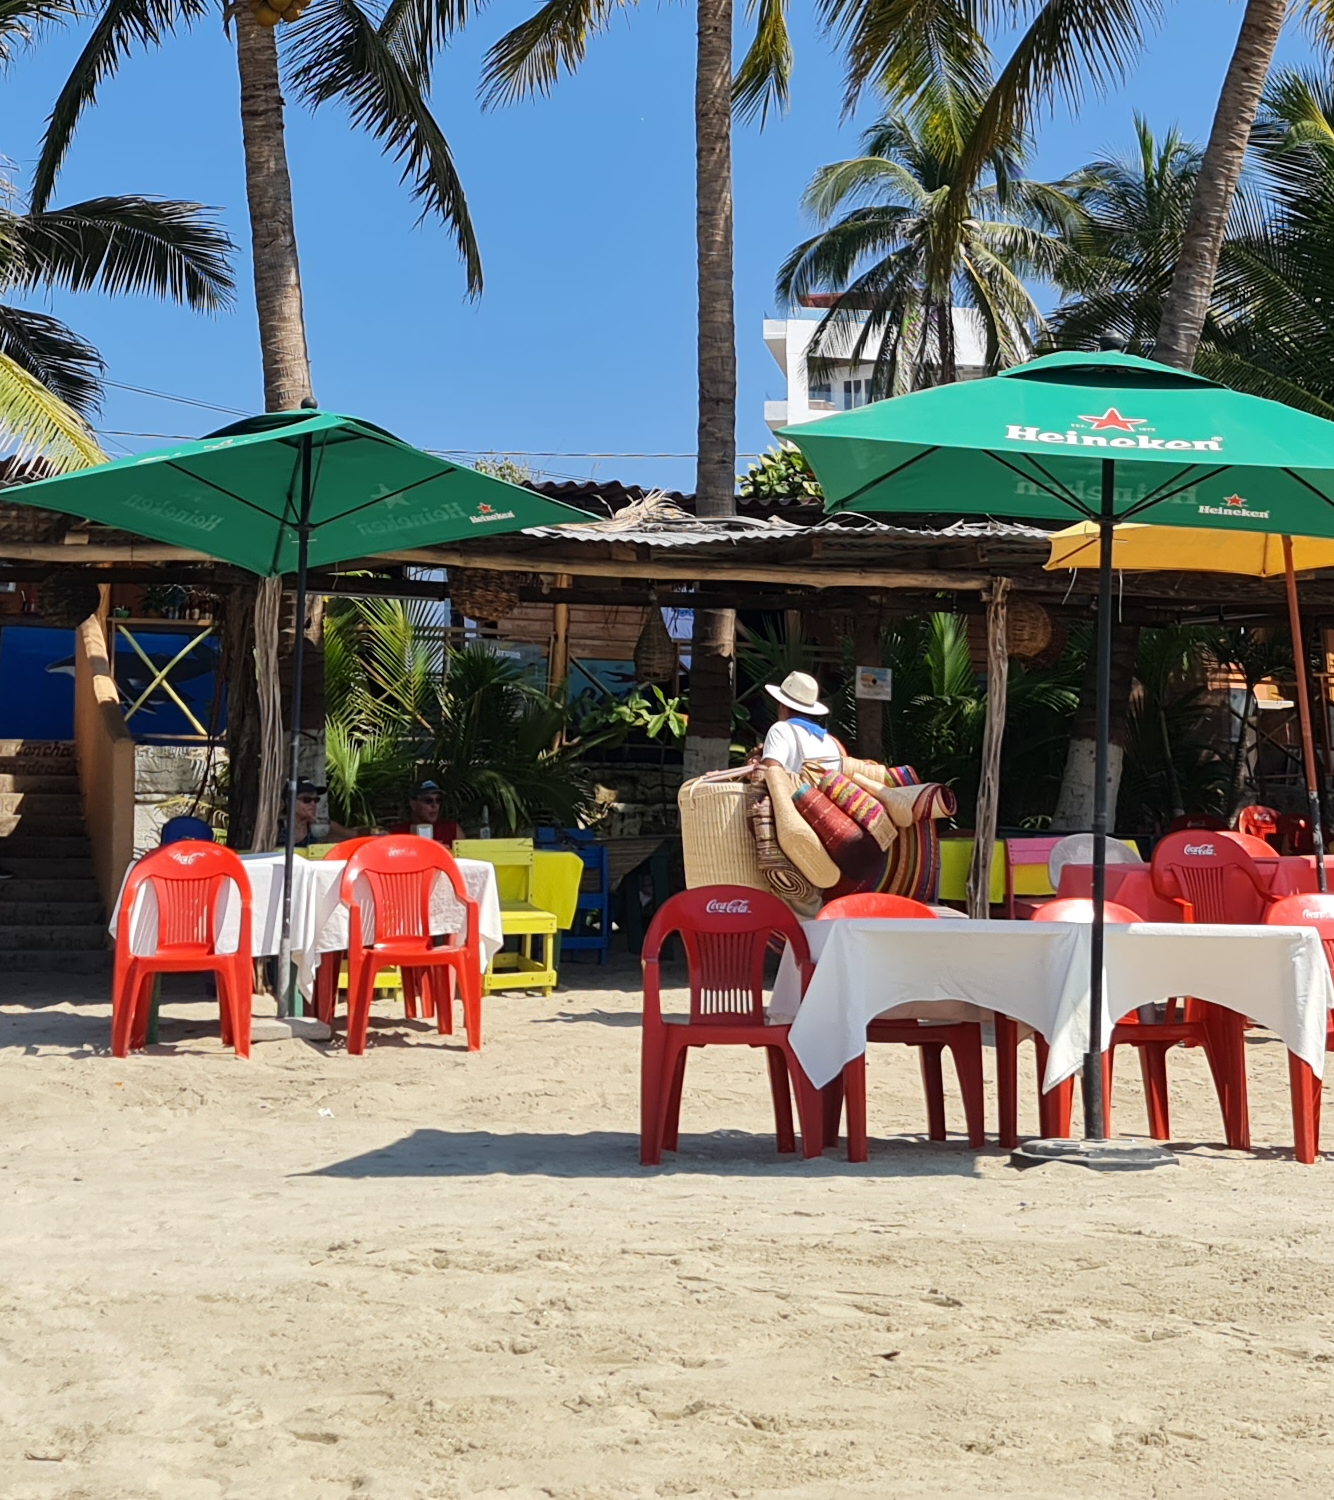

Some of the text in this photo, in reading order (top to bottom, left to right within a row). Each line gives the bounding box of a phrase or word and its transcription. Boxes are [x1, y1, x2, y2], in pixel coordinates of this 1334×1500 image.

[469, 510, 515, 524] Heineken
[1198, 505, 1269, 519] Heineken
[706, 899, 751, 913] Coca-Cola
